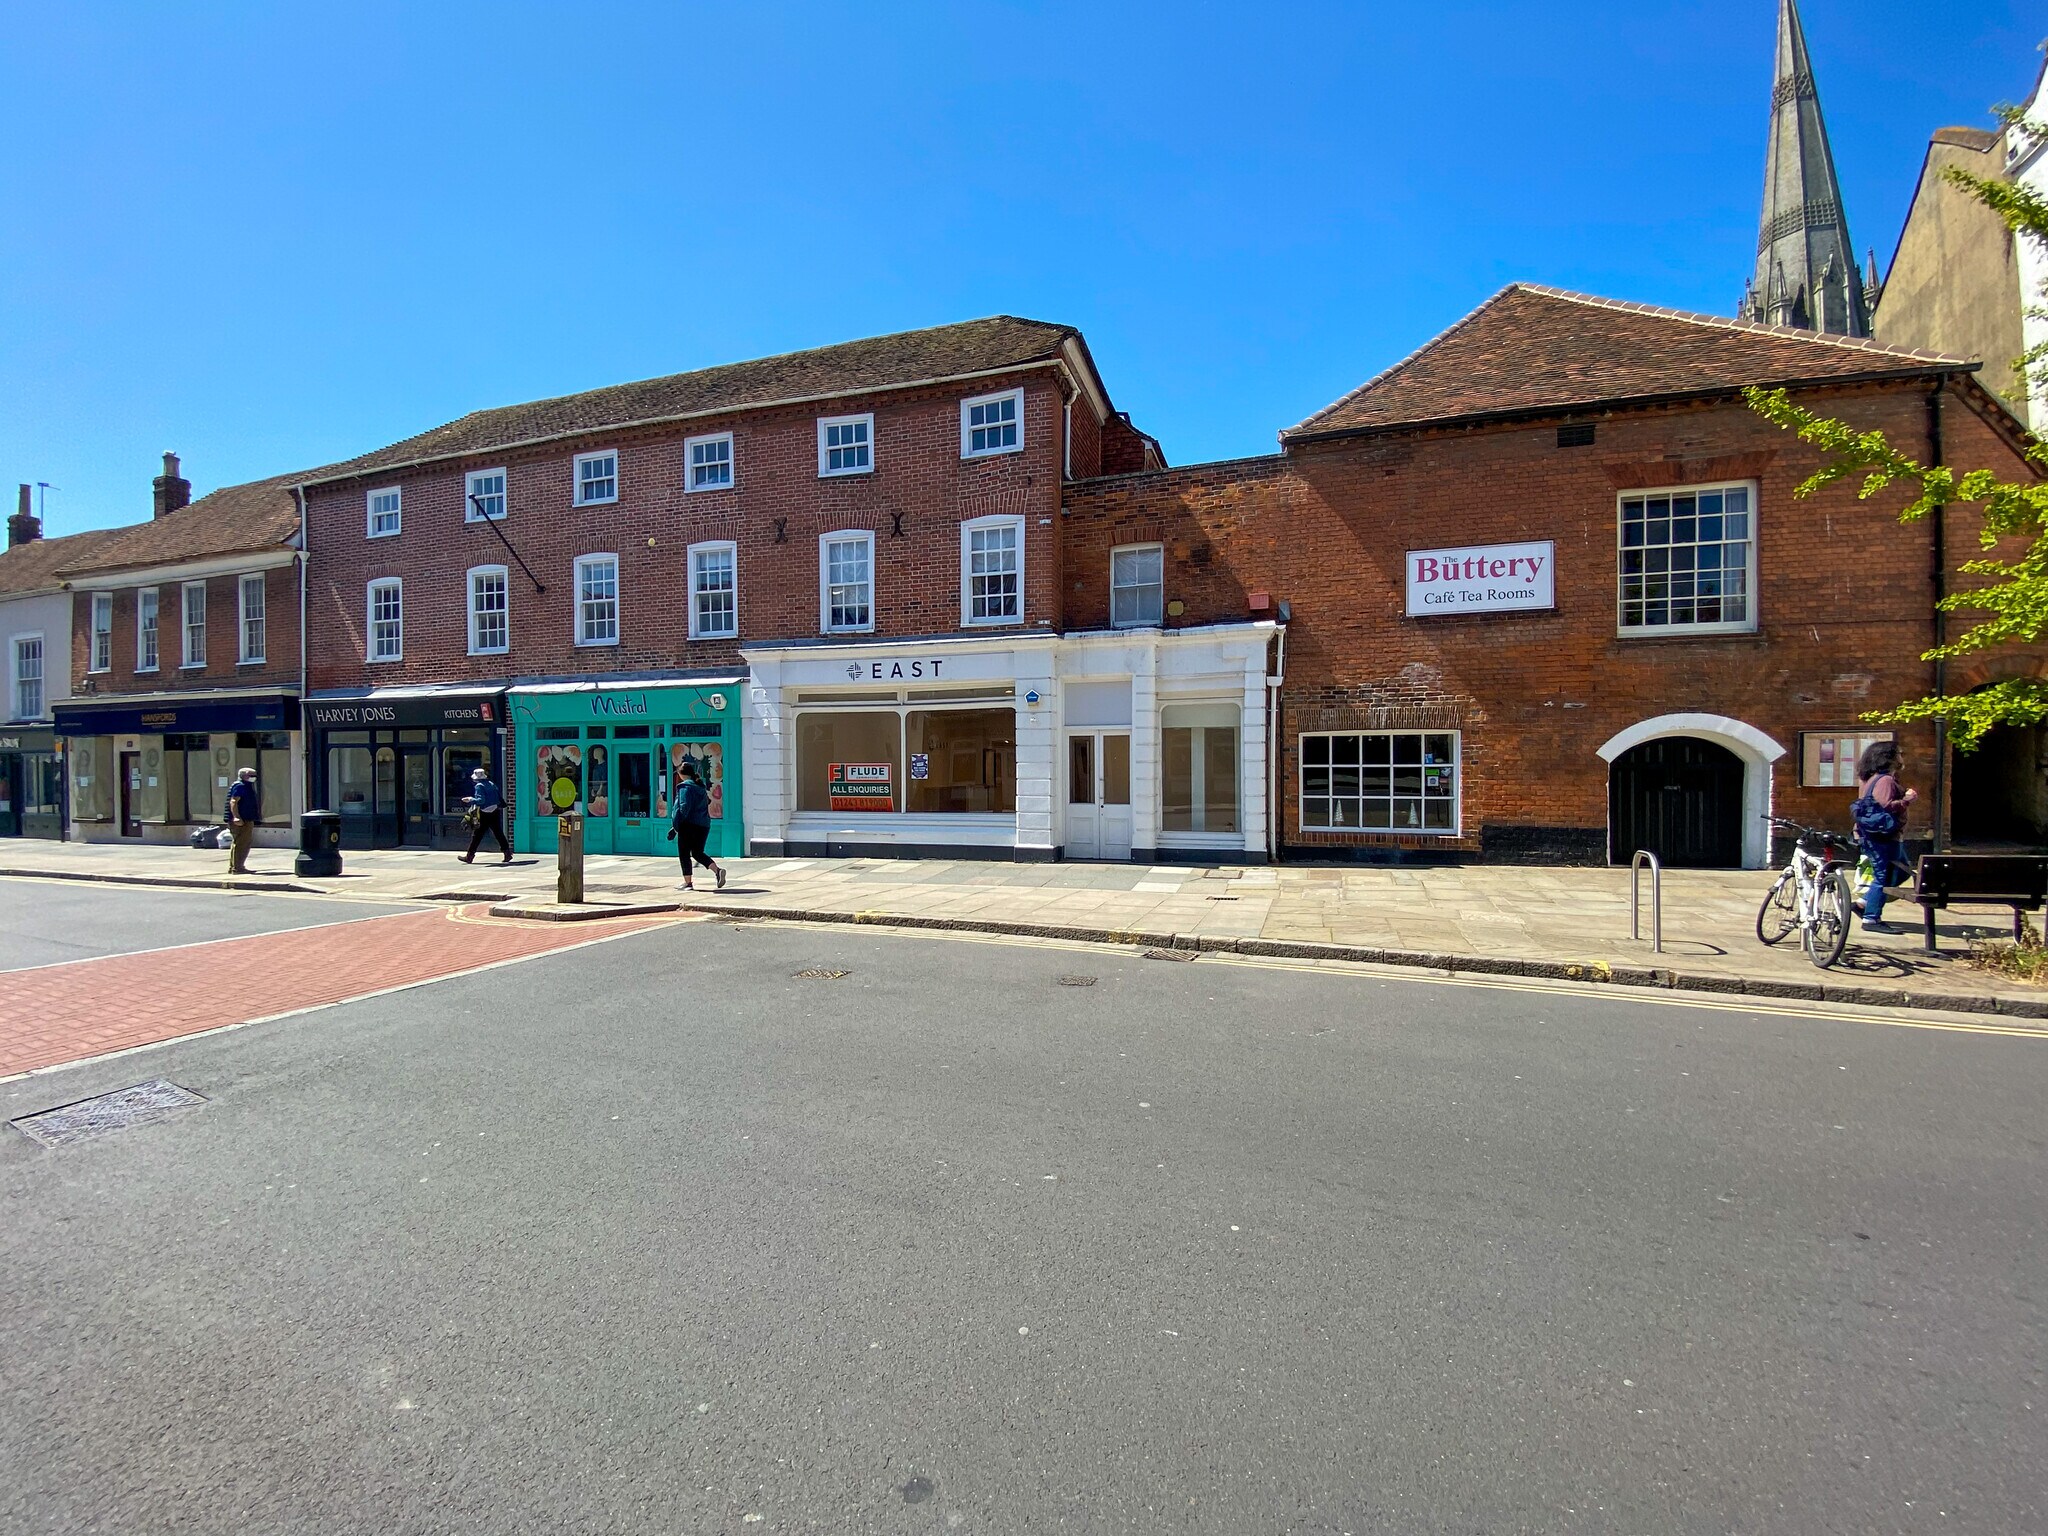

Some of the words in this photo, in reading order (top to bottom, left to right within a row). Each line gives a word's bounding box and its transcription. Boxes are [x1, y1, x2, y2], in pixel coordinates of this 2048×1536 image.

[1414, 555, 1545, 583] Buttery
[1424, 591, 1455, 604] Café
[1459, 590, 1482, 602] Tea
[1487, 588, 1535, 601] Rooms
[872, 660, 943, 679] EAST
[590, 692, 648, 716] Mistral
[141, 712, 177, 722] HANSFORDS
[315, 708, 358, 722] HARVEY
[361, 706, 396, 724] JONES
[443, 709, 479, 719] KITCHENS
[850, 767, 885, 776] FLUDE
[831, 785, 847, 794] ALL
[847, 785, 890, 794] ENQUIRIES
